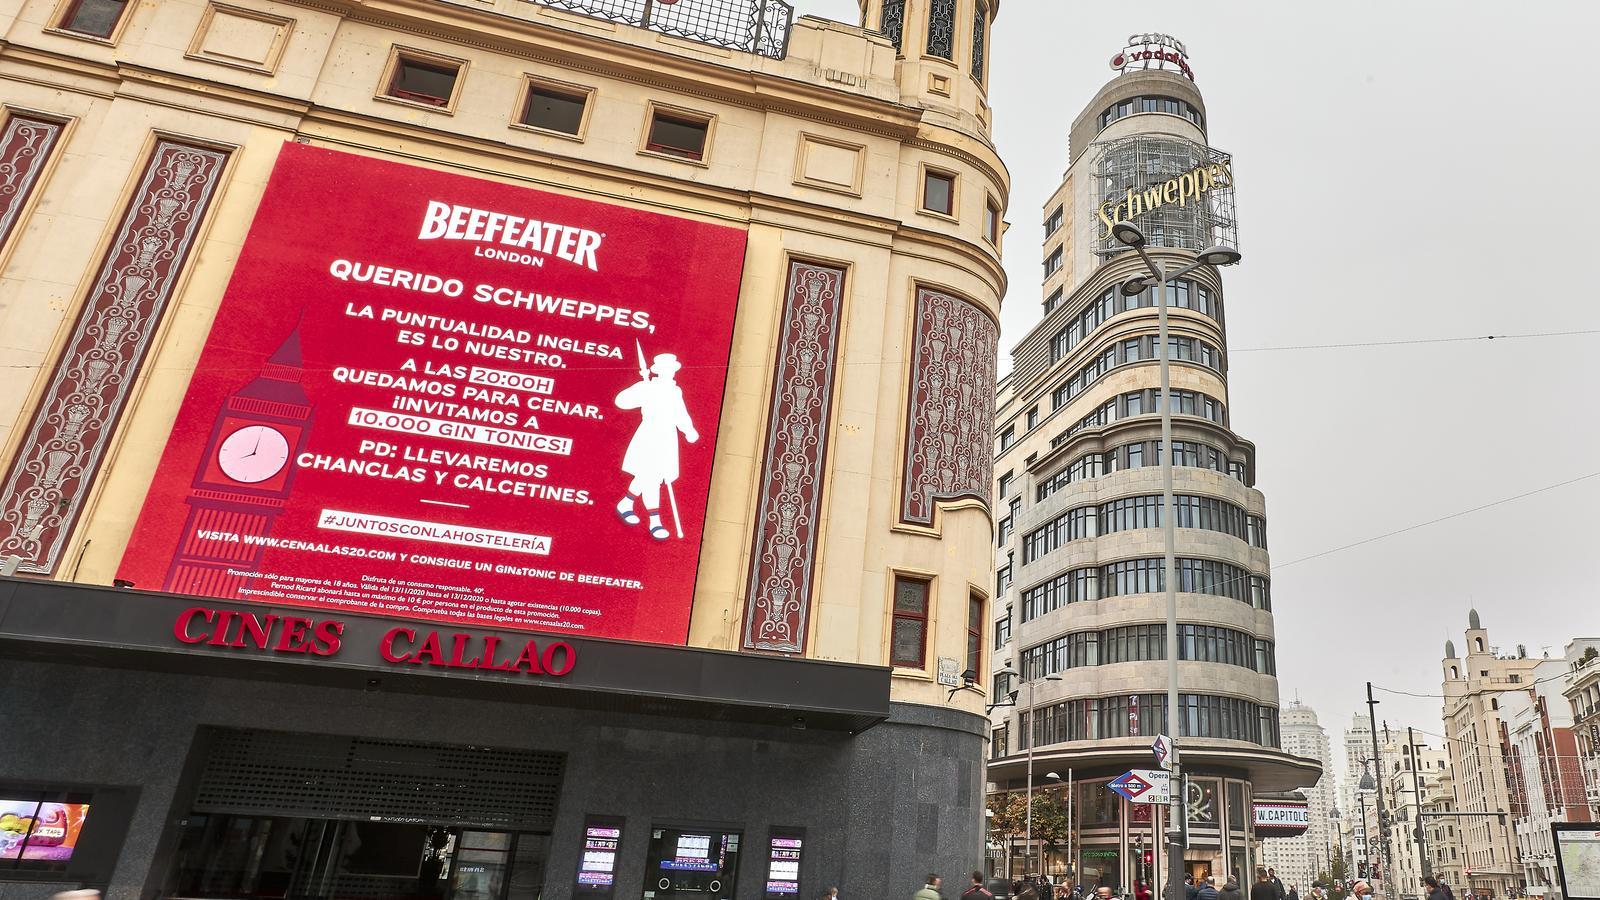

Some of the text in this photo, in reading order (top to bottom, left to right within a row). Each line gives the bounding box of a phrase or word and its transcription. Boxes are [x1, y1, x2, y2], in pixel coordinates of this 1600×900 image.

[1128, 32, 1189, 59] CAPITOL
[1098, 160, 1233, 240] Schweppes
[474, 245, 544, 267] LONDON
[329, 258, 655, 334] QUERIDO SCHWEPPES,
[345, 302, 623, 360] LA PUNTUALIDAD INGLESA
[397, 329, 566, 369] ES LO NUESTRO.
[332, 366, 603, 420] QUEDAMOS PARA CENAR.
[399, 358, 550, 392] A LAS 20:00H
[355, 410, 567, 453] 10.000 GIN TONICS!
[392, 395, 539, 430] ¡INVITAMOS A
[296, 452, 594, 505] CHANCLAS Y CALCETINES.
[358, 439, 548, 479] PD: LLEVAREMOS
[323, 515, 545, 551] #JUNTOSCONLAHOSTELERÍA
[197, 529, 644, 590] VISITA WWW.CENAALAS20.COM Y CONSIGUE UN GIN&TONIC DE BEEFEATER.
[173, 606, 578, 677] CINES CALLAO
